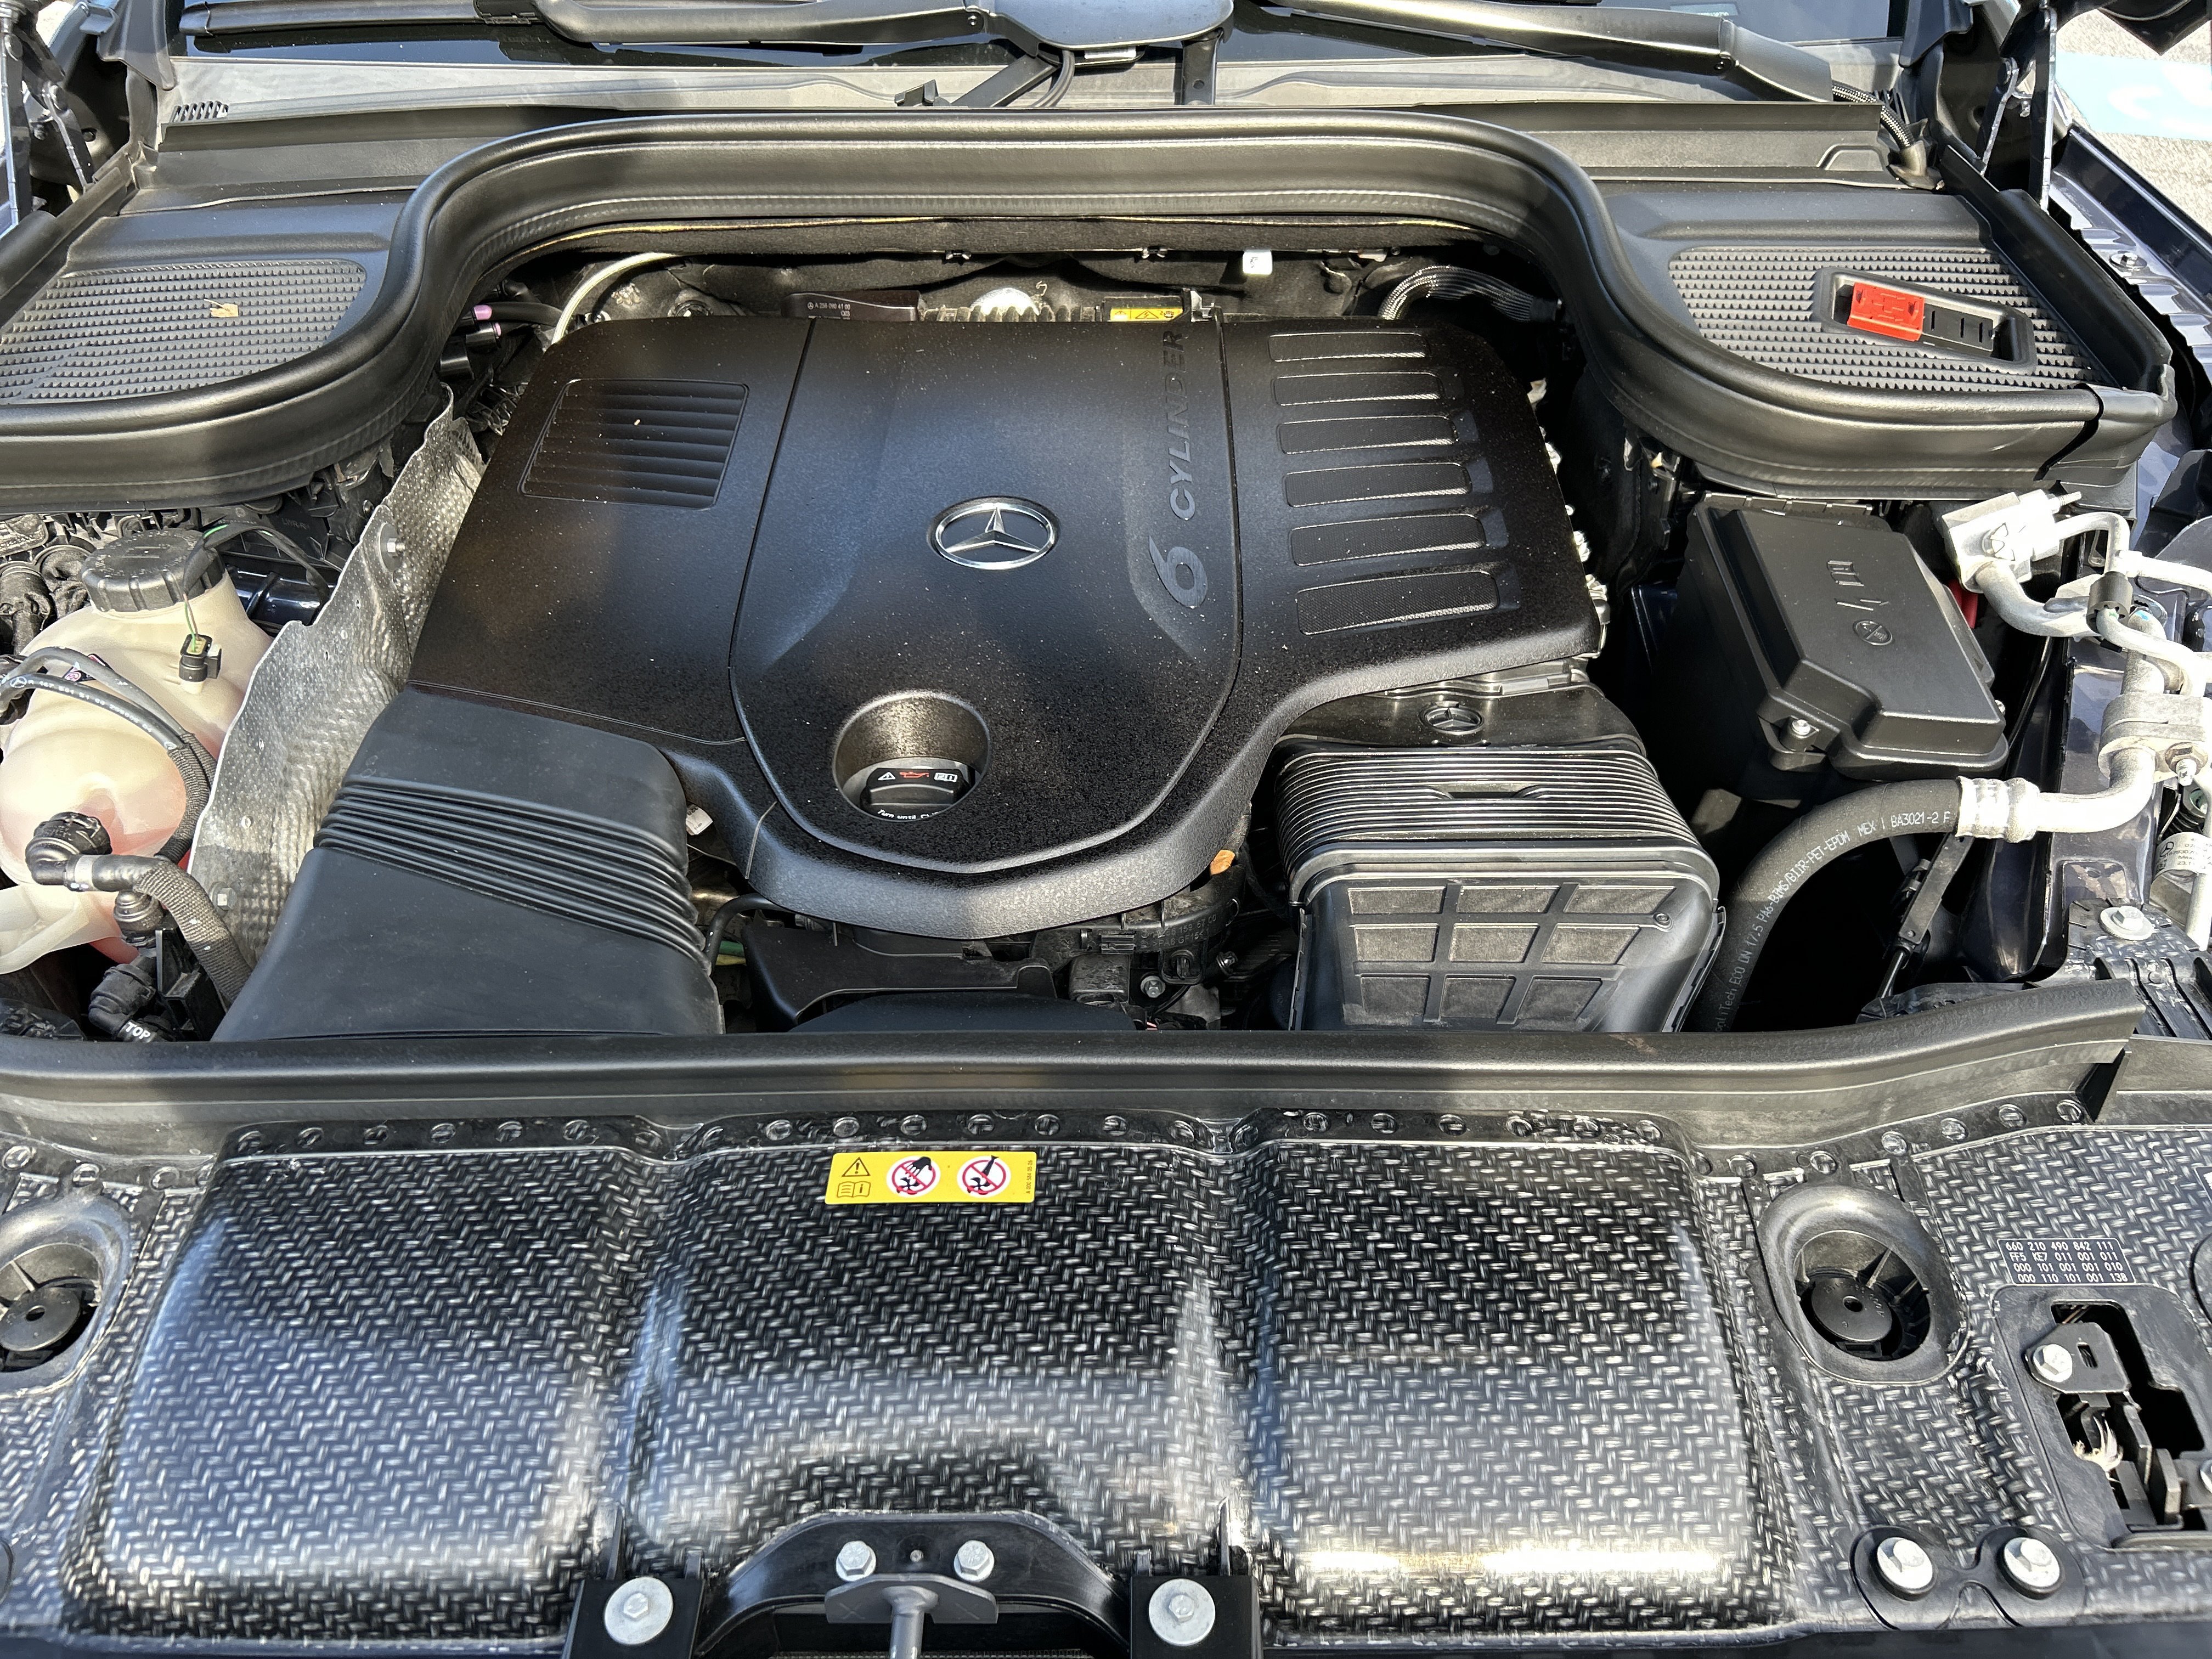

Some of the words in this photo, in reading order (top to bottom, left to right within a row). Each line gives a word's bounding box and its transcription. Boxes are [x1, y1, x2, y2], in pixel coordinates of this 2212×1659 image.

[1163, 330, 1196, 521] CYLINDER
[1149, 535, 1207, 608] 6
[877, 809, 895, 819] Turn
[1729, 966, 1746, 985] ECO
[1738, 950, 1753, 964] DN
[1857, 820, 1876, 837] MEX
[1891, 811, 1939, 828] BA3021-2
[1943, 811, 1950, 823] F
[126, 1022, 151, 1040] TOP
[2006, 1241, 2023, 1251] 660
[2027, 1241, 2046, 1251] 210
[2051, 1241, 2069, 1251] 490
[2074, 1241, 2092, 1251] 842
[2096, 1241, 2113, 1251] 111
[2009, 1252, 2027, 1261] FF5
[2032, 1252, 2048, 1261] KE7
[2055, 1252, 2072, 1261] 011
[2078, 1252, 2095, 1261] 001
[2100, 1252, 2117, 1261] 011
[2013, 1262, 2032, 1272] 000
[2037, 1262, 2054, 1272] 101
[2059, 1262, 2077, 1272] 001
[2082, 1262, 2100, 1272] 001
[2104, 1262, 2123, 1272] 010
[2018, 1273, 2036, 1283] 000
[2041, 1273, 2058, 1283] 110
[2064, 1273, 2081, 1283] 101
[2086, 1273, 2104, 1283] 001
[2109, 1273, 2128, 1283] 138
